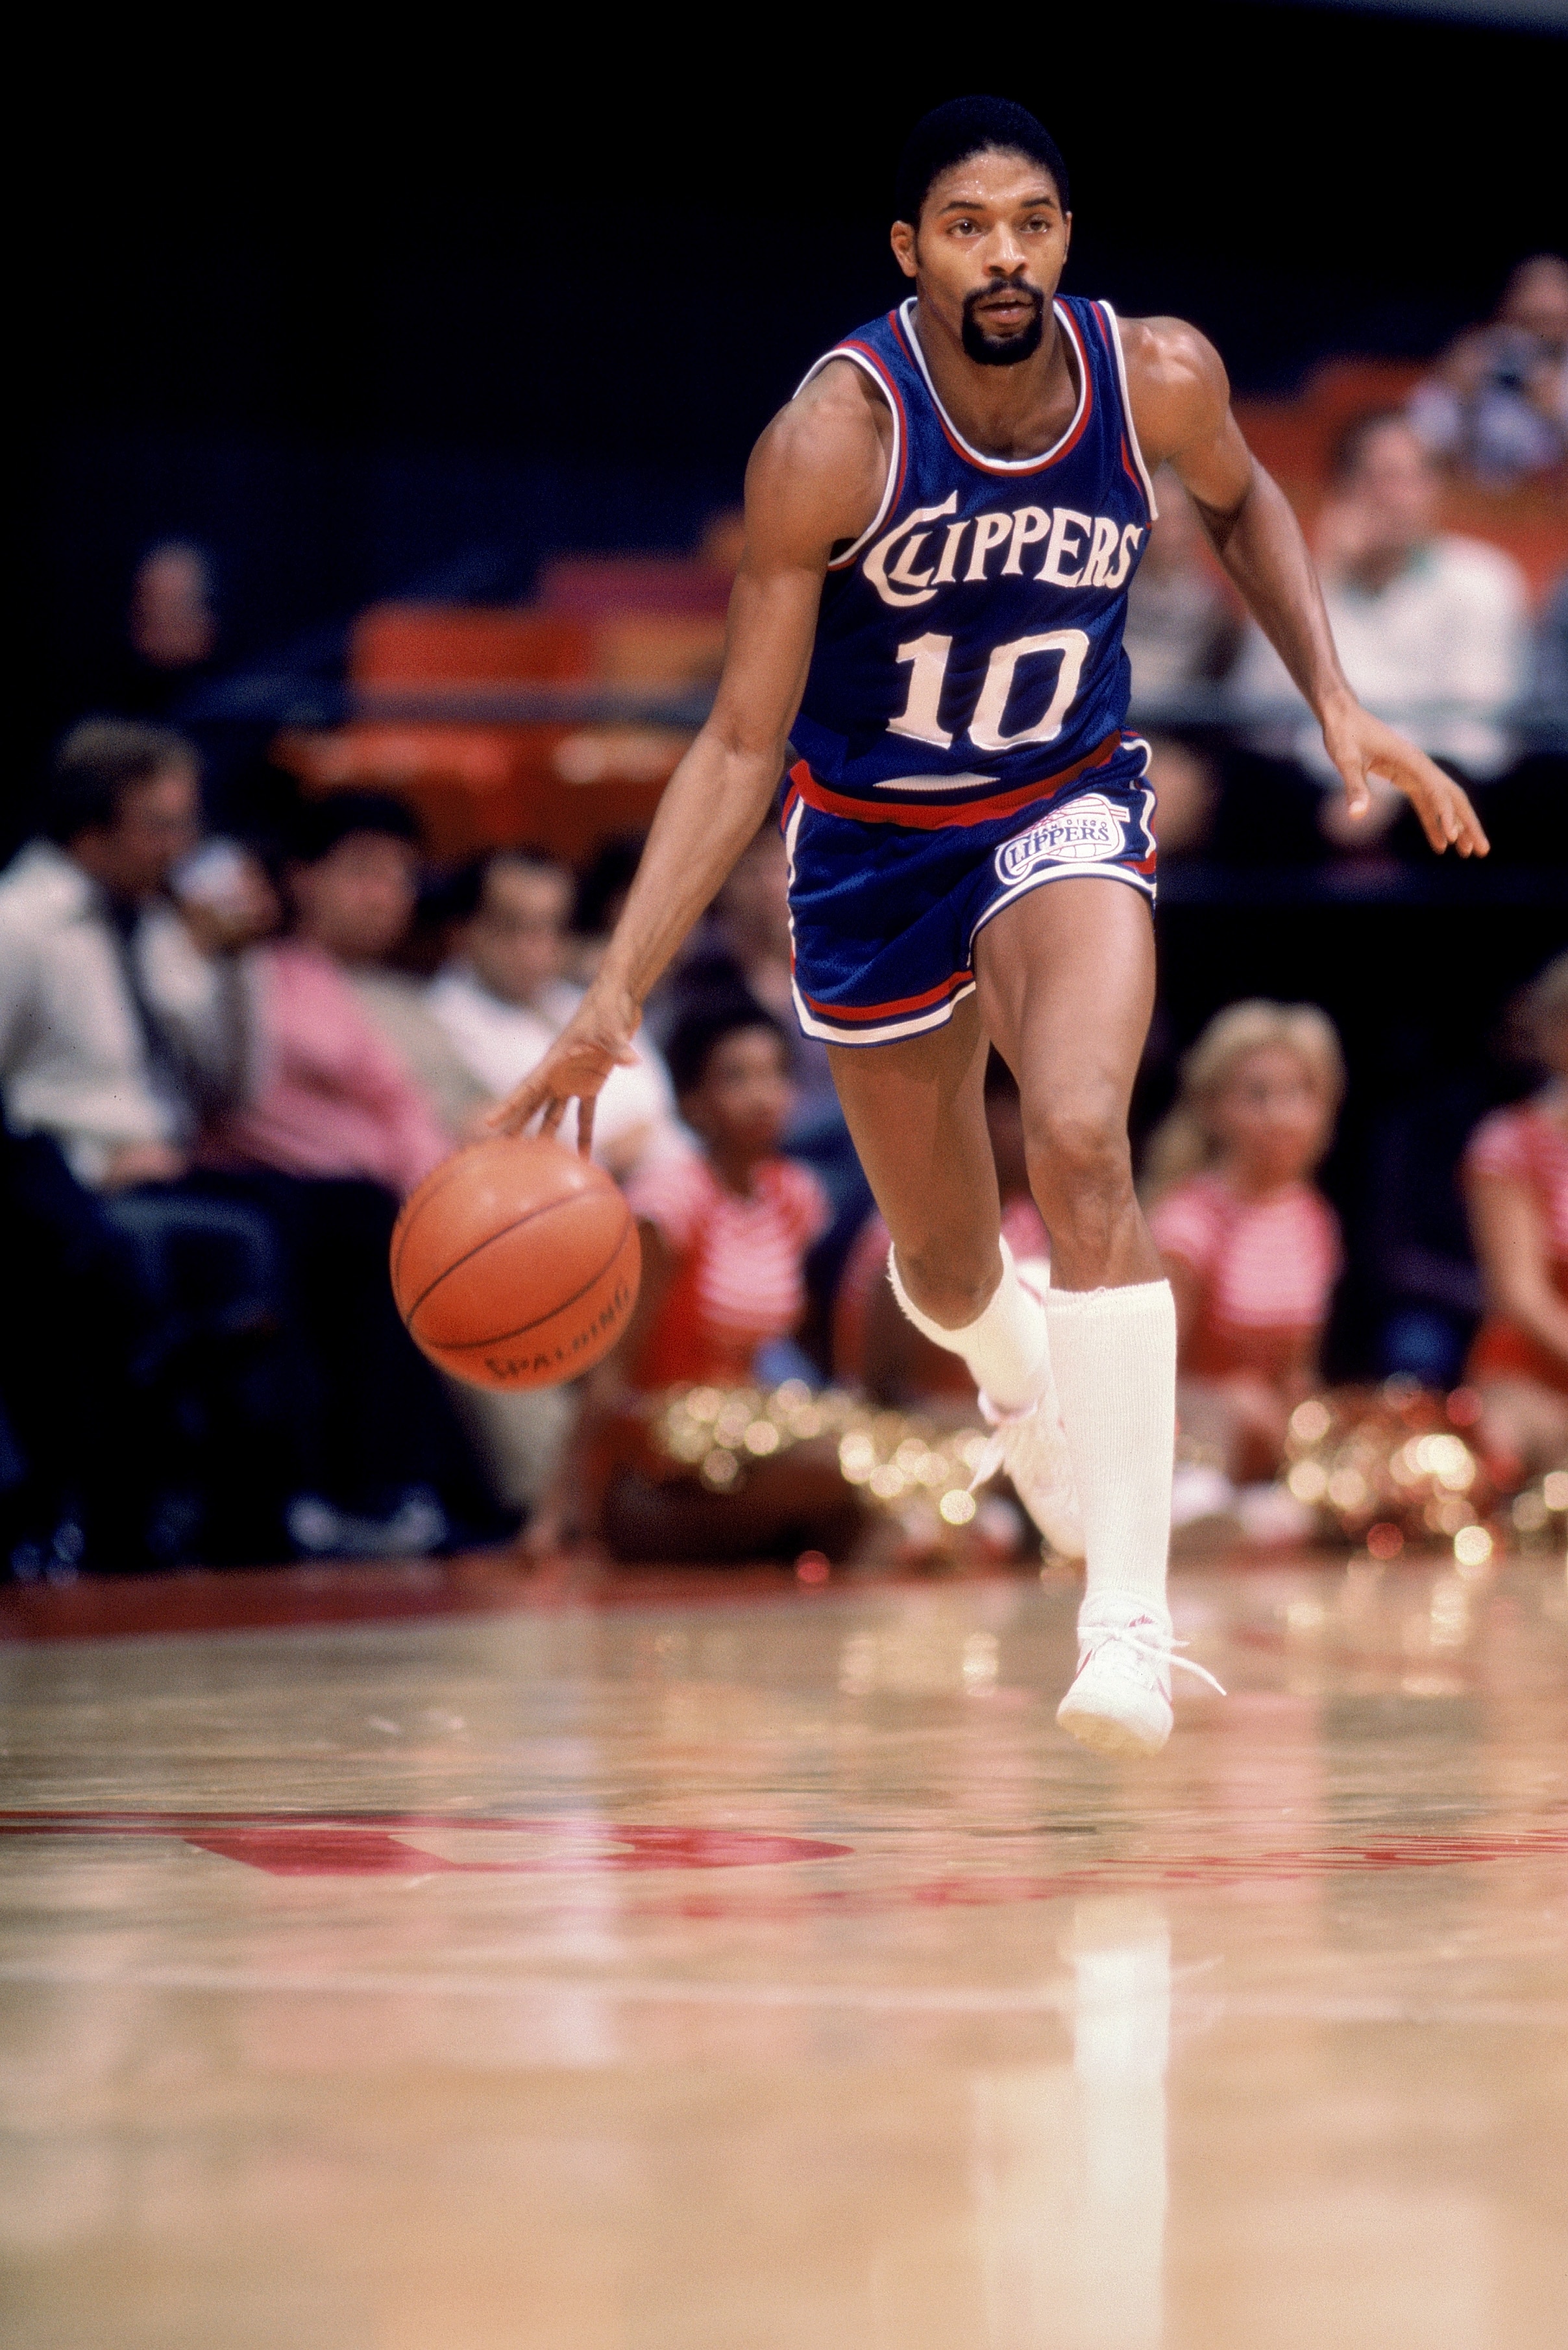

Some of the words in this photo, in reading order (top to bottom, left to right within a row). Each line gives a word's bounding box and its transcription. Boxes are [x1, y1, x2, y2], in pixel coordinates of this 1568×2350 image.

[863, 489, 1144, 607] CLIPPERS
[885, 628, 1090, 751] 10
[999, 826, 1110, 880] CLIPPERS
[485, 1280, 630, 1378] SPALDING
